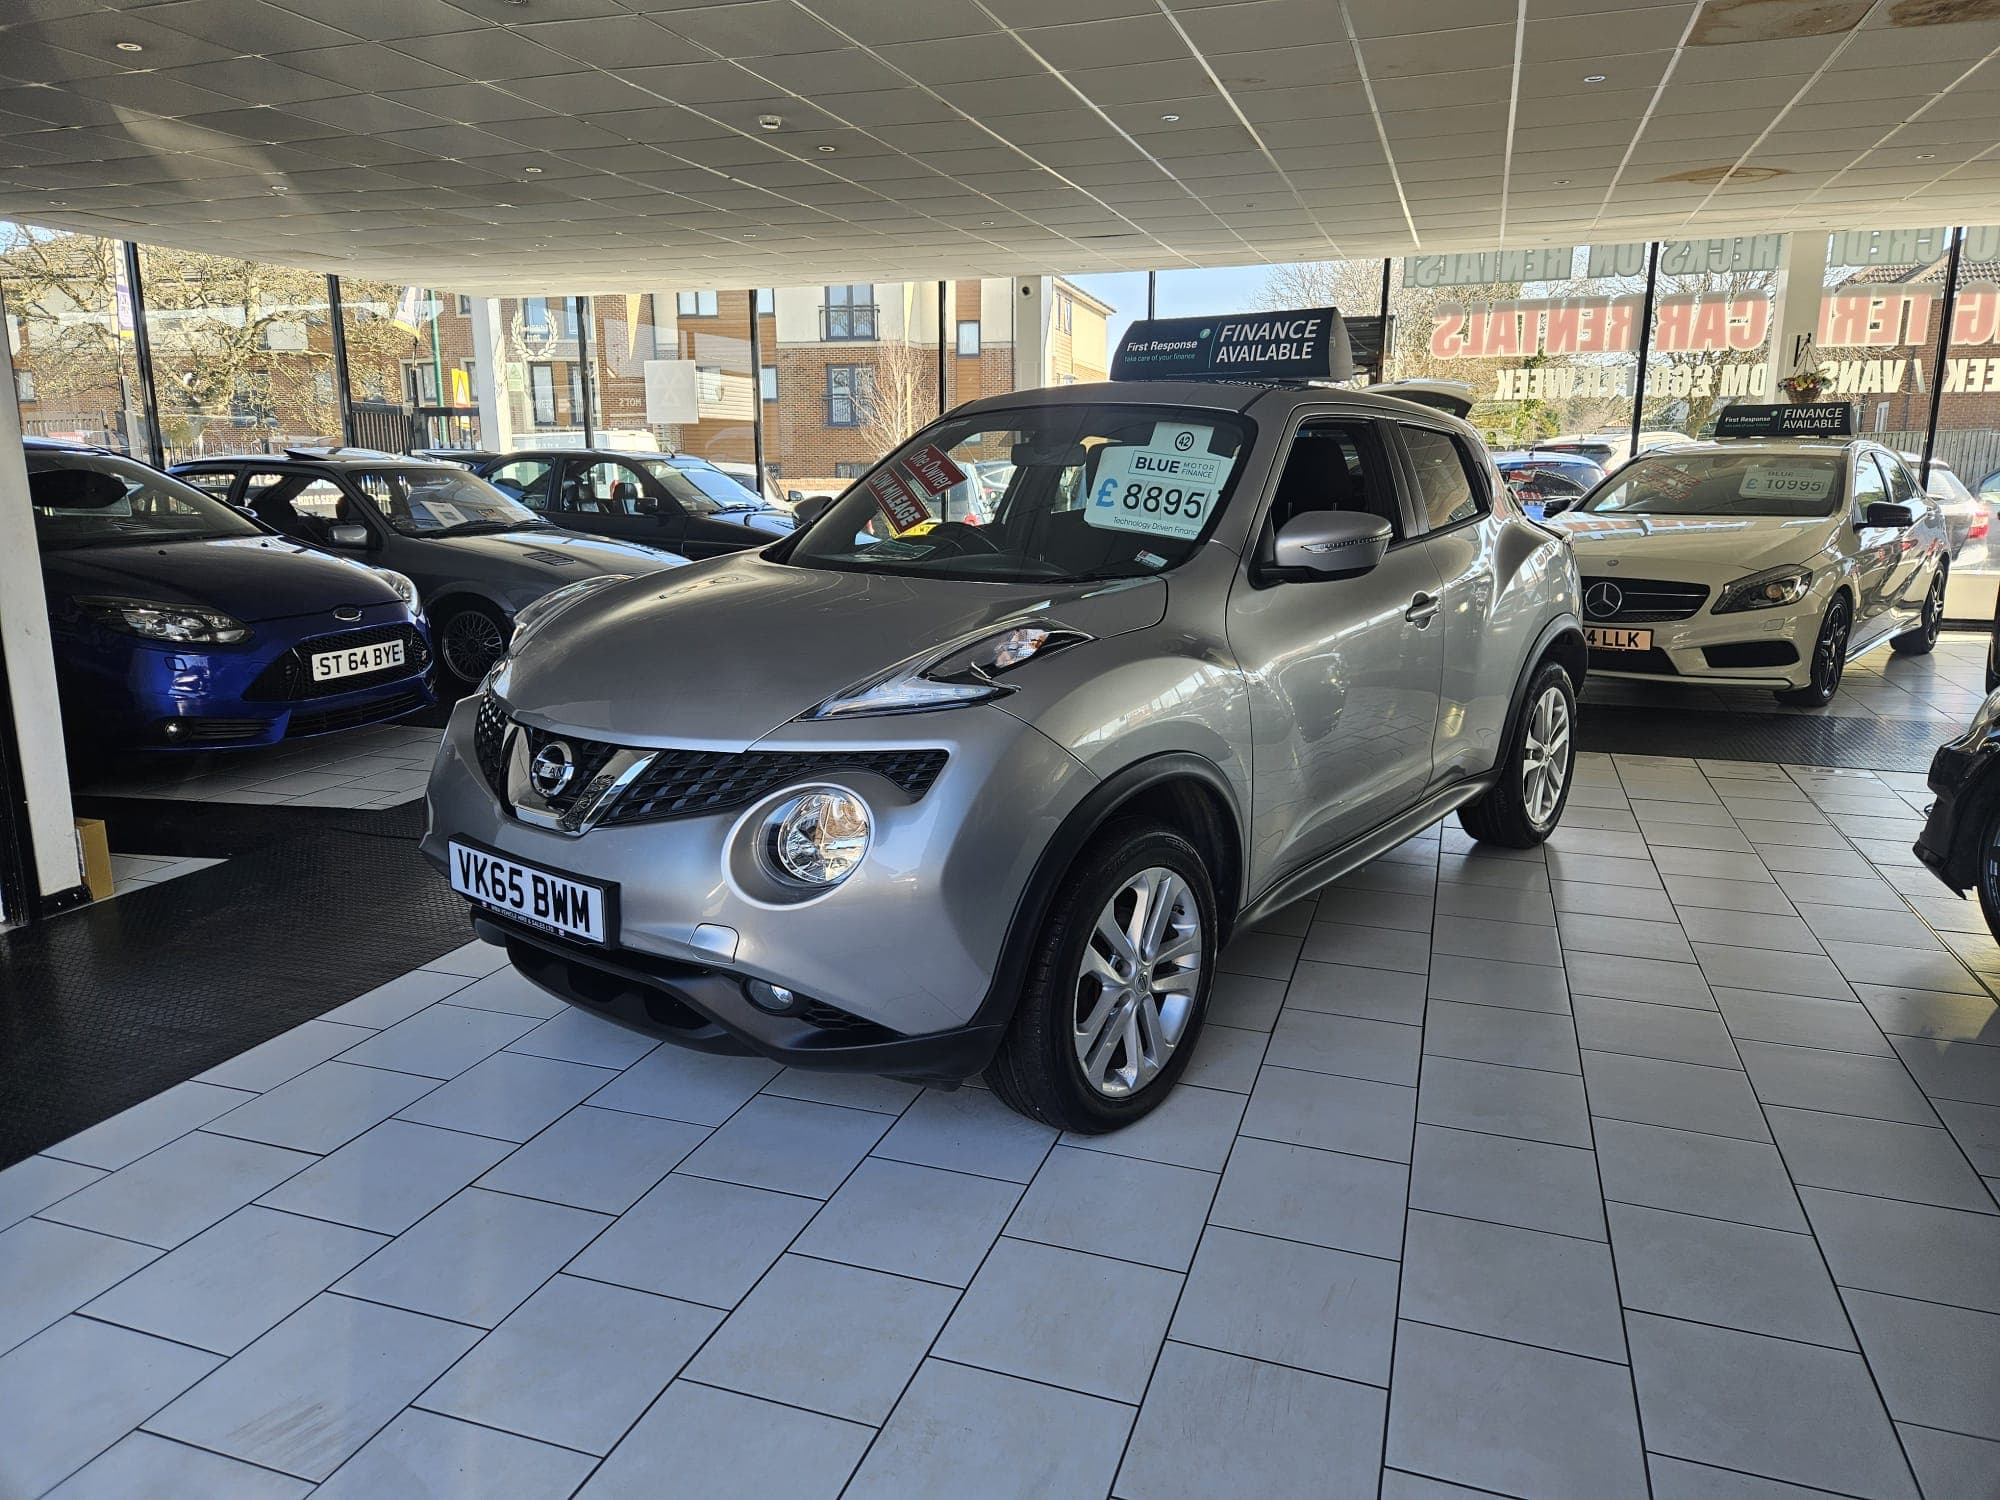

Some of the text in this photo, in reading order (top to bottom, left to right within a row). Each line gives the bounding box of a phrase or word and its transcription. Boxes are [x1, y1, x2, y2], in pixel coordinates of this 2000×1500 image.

[1220, 319, 1321, 343] FINANCE
[1127, 341, 1198, 352] First Response
[1216, 341, 1314, 363] AVAILABLE
[1159, 354, 1173, 362] your
[1740, 416, 1771, 424] Response
[1783, 408, 1844, 419] FINANCE
[1783, 419, 1842, 429] AVAILABLE
[1178, 435, 1191, 447] 42
[910, 448, 952, 489] One Owner
[1135, 457, 1181, 474] BLUE
[1183, 462, 1215, 472] MOTOR
[1181, 468, 1214, 479] FINANCE
[1766, 479, 1822, 493] 10995
[871, 471, 921, 527] LOW MILEAGE
[1096, 478, 1205, 519] £ 8895
[1113, 516, 1198, 536] Technology Driven Financ
[1602, 630, 1640, 648] LLK
[320, 655, 342, 676] ST
[348, 651, 369, 671] 64
[373, 643, 401, 667] BYE
[458, 848, 590, 933] VK65 BWM
[532, 920, 546, 930] SALES
